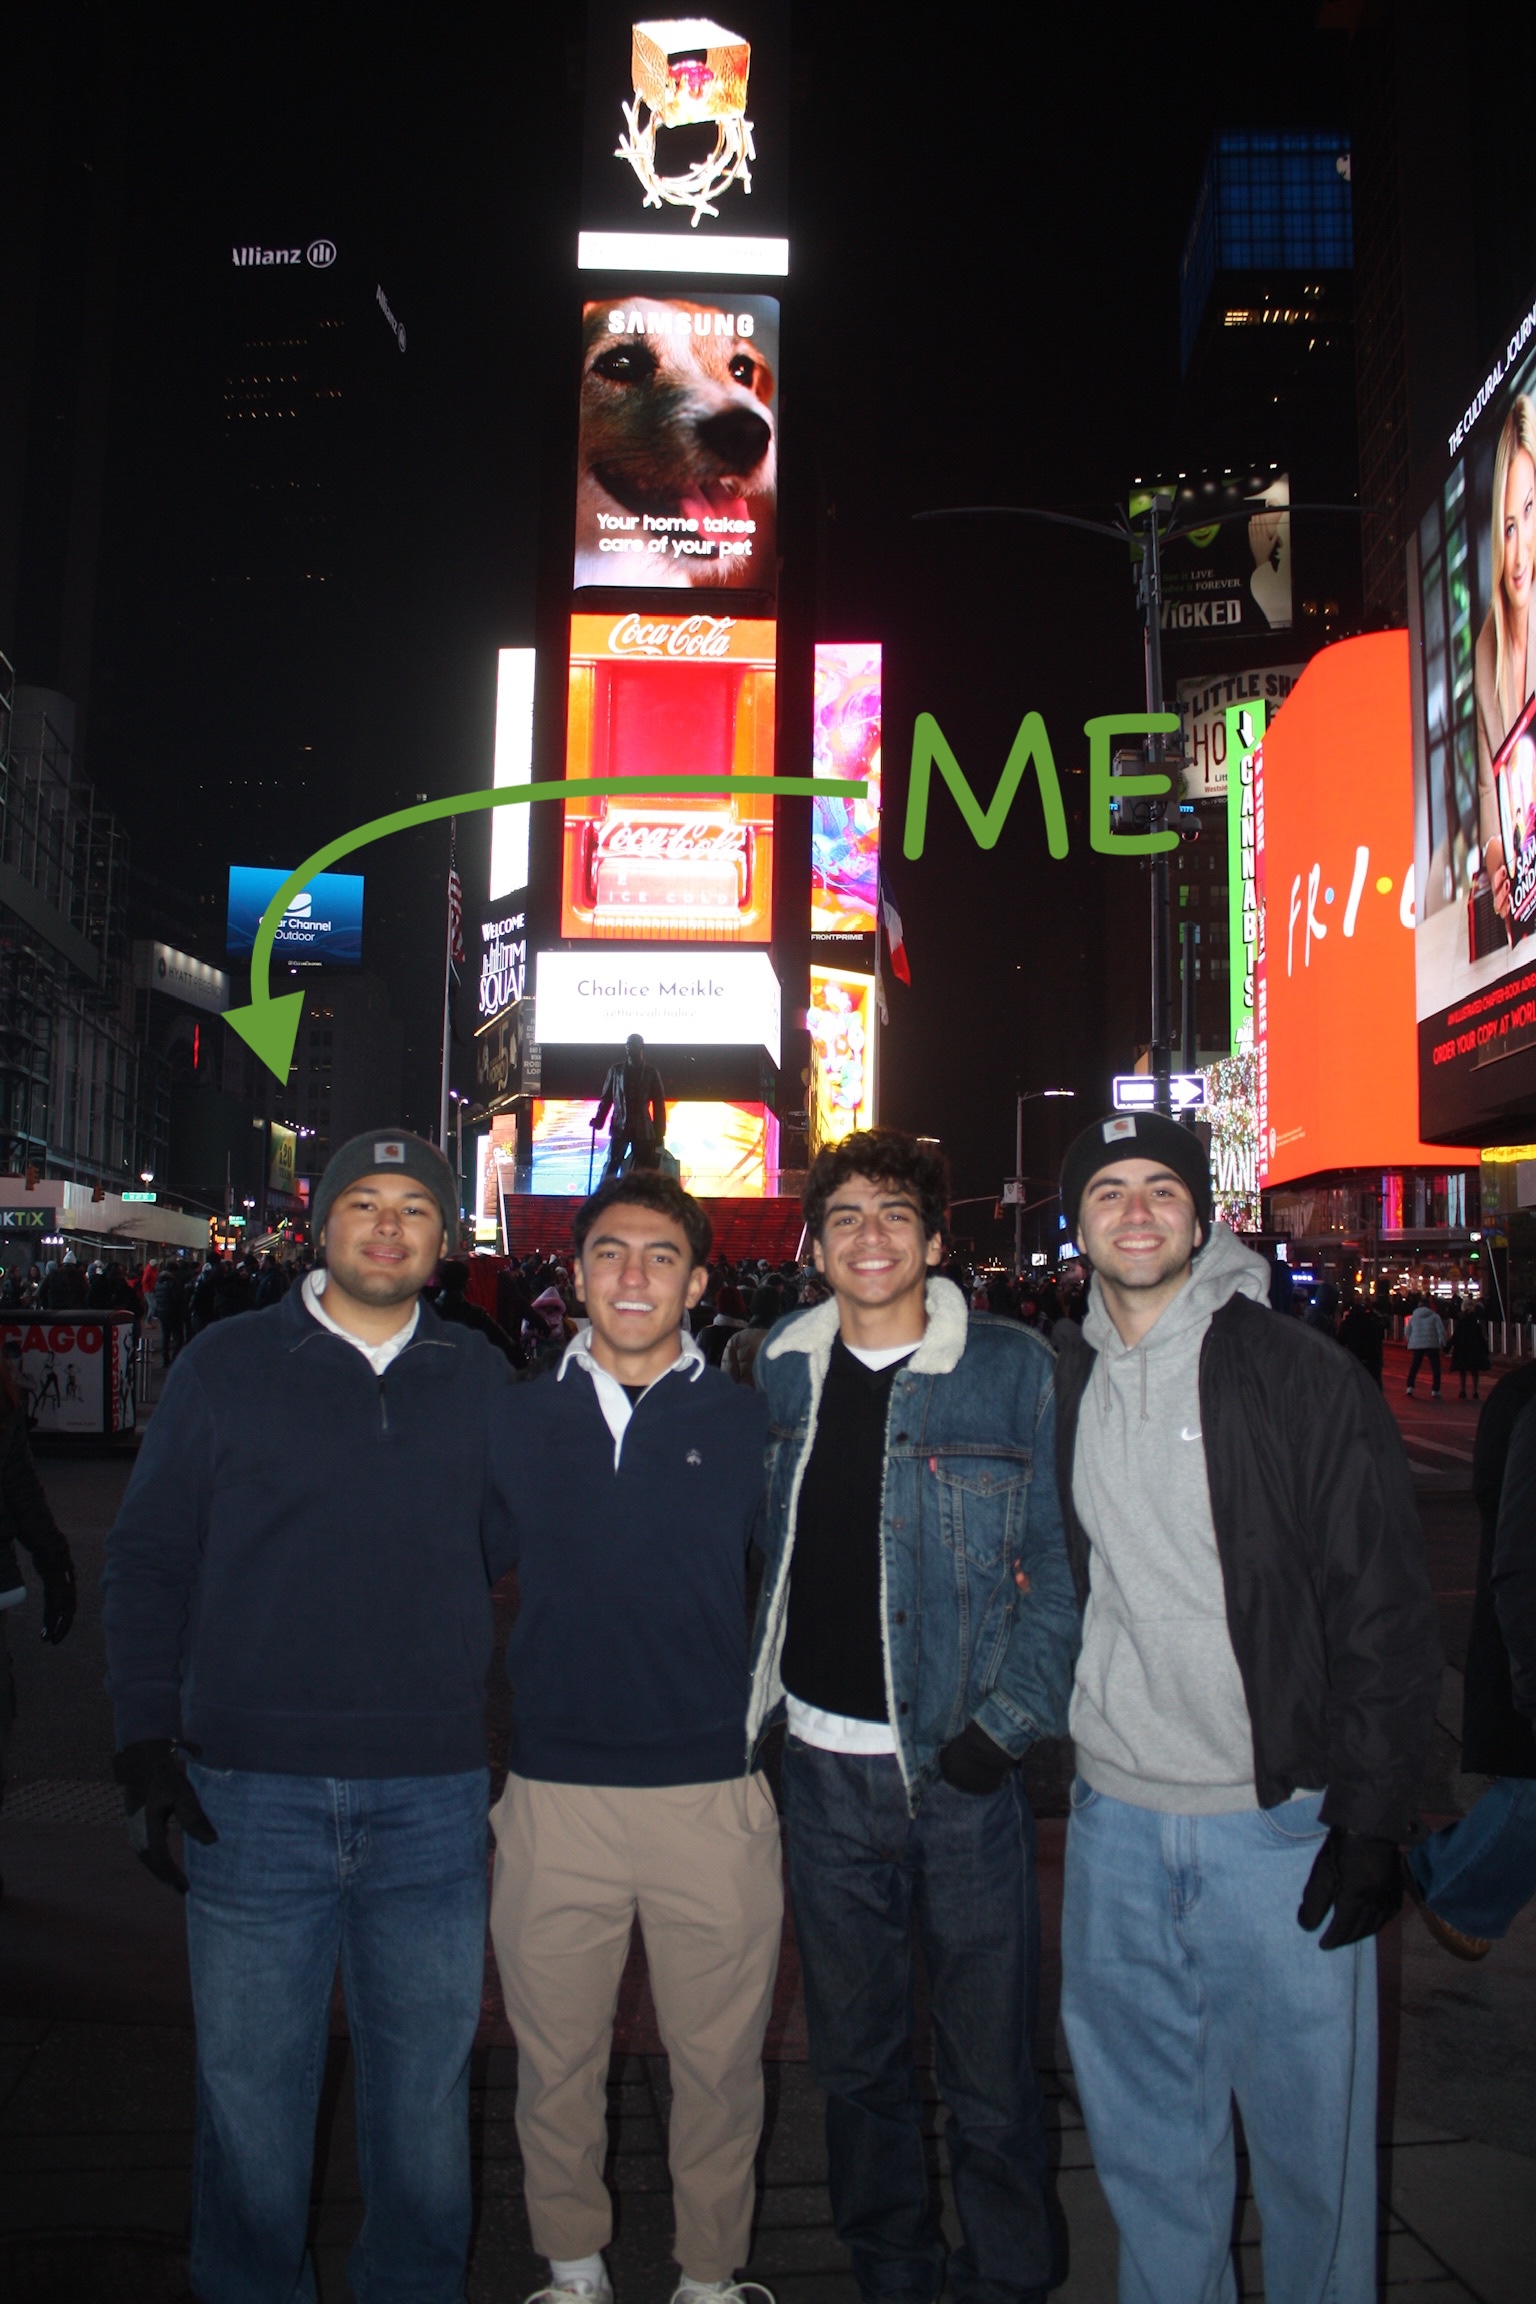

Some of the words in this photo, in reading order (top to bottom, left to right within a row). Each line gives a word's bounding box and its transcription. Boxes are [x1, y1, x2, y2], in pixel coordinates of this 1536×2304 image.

[232, 247, 301, 266] Allianz
[608, 310, 754, 337] SAMSUNG
[1448, 420, 1464, 457] THE
[1463, 360, 1504, 433] CULTURAL
[596, 513, 640, 530] Your
[642, 514, 699, 532] home
[703, 516, 756, 534] takes
[599, 537, 644, 552] care
[647, 535, 669, 553] of
[671, 537, 716, 558] your
[719, 539, 753, 559] pet
[607, 612, 737, 656] Coca-Cola
[1192, 673, 1261, 718] LITTLE
[1239, 754, 1257, 1009] CANNABIS
[609, 892, 648, 903] ICE
[666, 891, 728, 905] COLD
[275, 929, 315, 941] Outdoor
[288, 918, 331, 931] Channel
[482, 913, 525, 942] WELCOME
[168, 964, 193, 988] HYATT
[577, 980, 650, 997] Chalice
[659, 980, 724, 997] Meikle
[1258, 979, 1267, 1035] FREE
[1433, 1040, 1456, 1065] ORDER
[1456, 1030, 1477, 1054] YOUR
[1477, 1020, 1498, 1045] COPY
[1499, 1014, 1510, 1036] AT
[1258, 1040, 1268, 1176] CHOCOLATE
